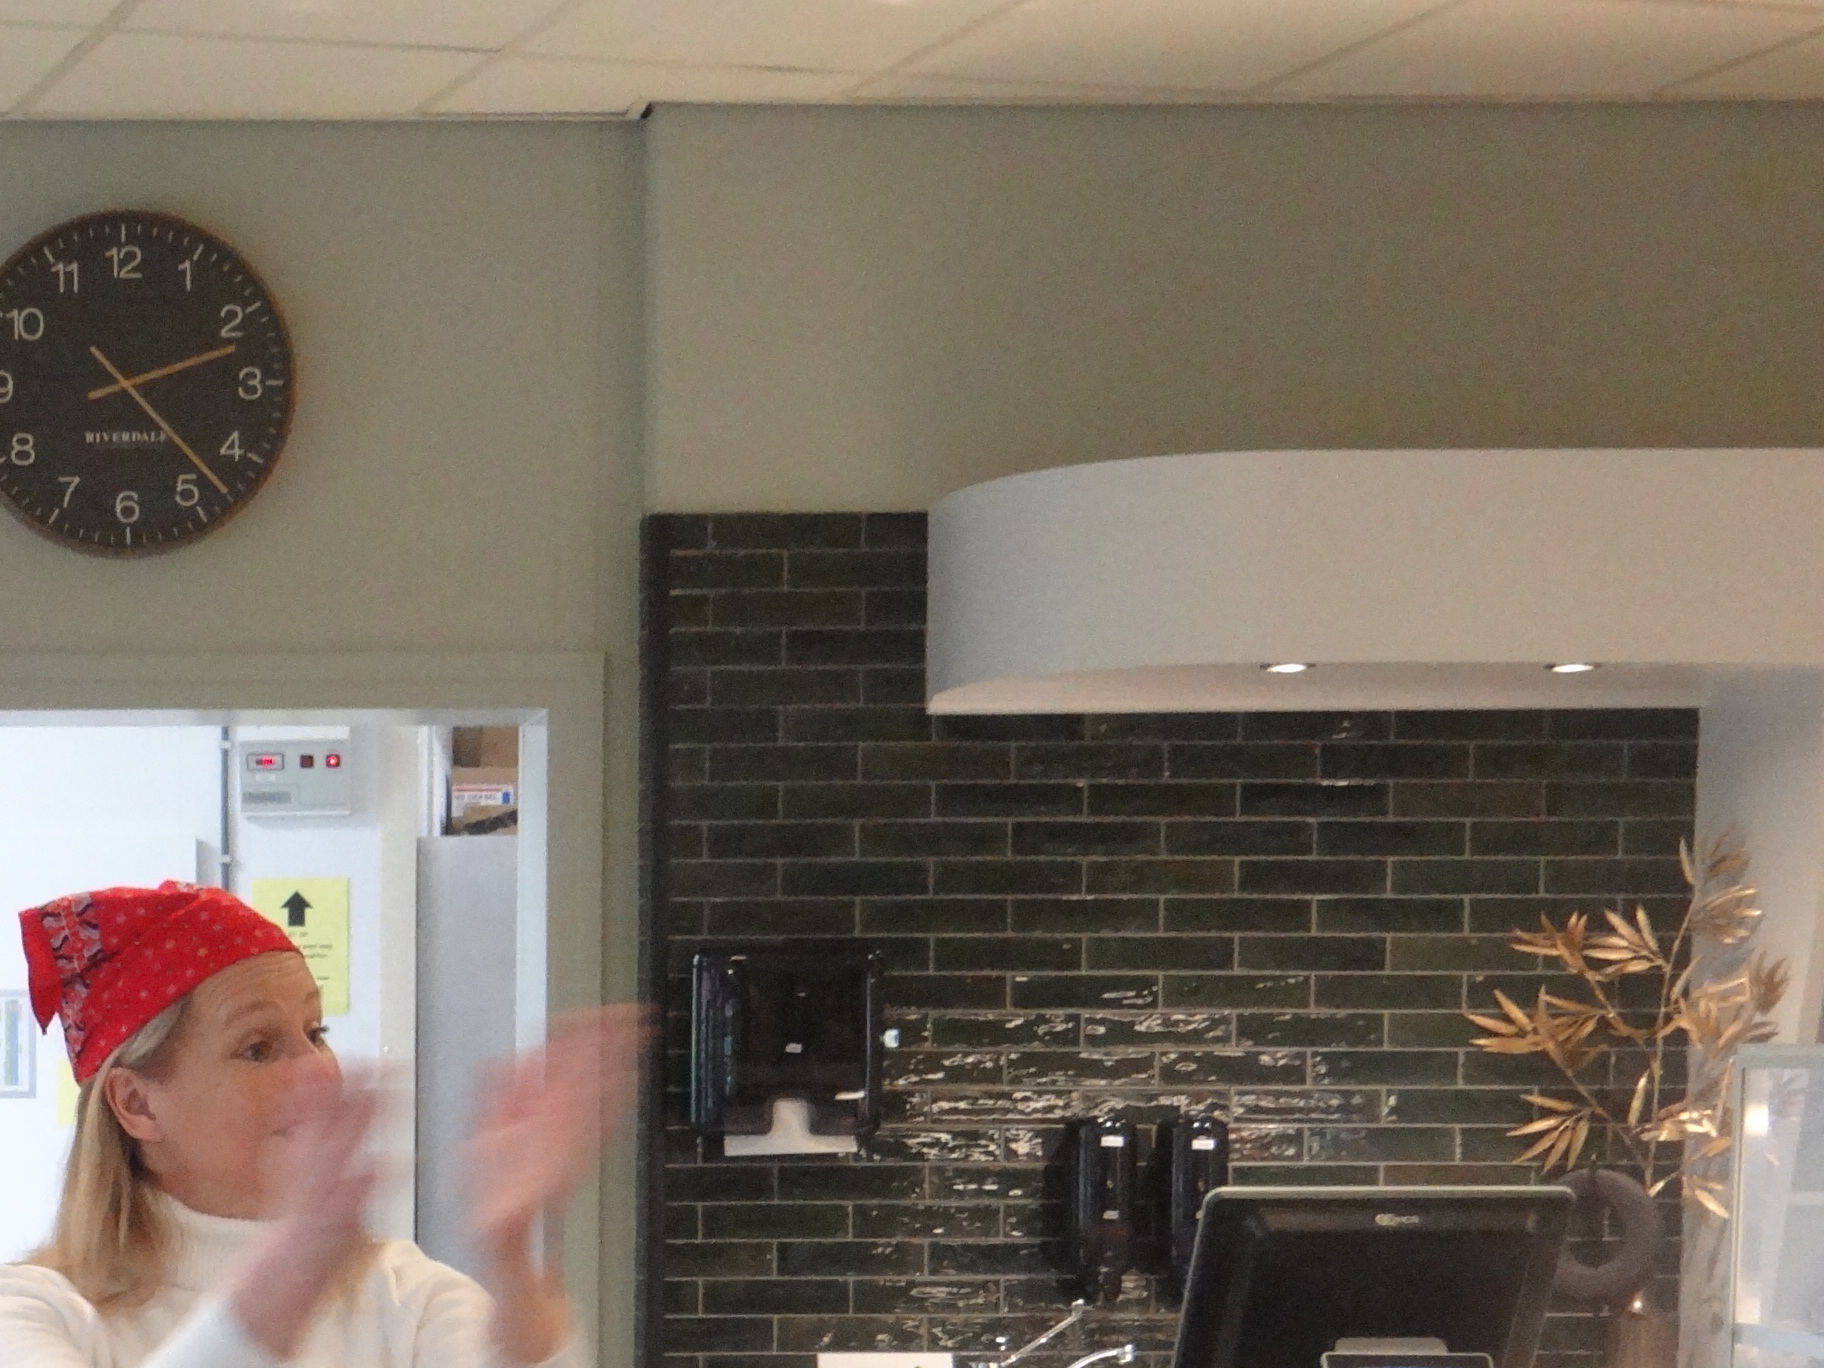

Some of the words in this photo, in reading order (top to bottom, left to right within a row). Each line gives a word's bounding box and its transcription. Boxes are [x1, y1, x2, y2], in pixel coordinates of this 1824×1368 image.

[50, 260, 79, 293] 11
[105, 245, 143, 279] 12
[178, 258, 192, 293] 1
[5, 307, 44, 341] 10
[220, 303, 244, 338] 2
[238, 366, 263, 400] 3
[10, 432, 36, 466] 8
[219, 430, 246, 463] 4
[57, 475, 81, 508] 7
[175, 473, 200, 507] 5
[115, 490, 141, 525] 6
